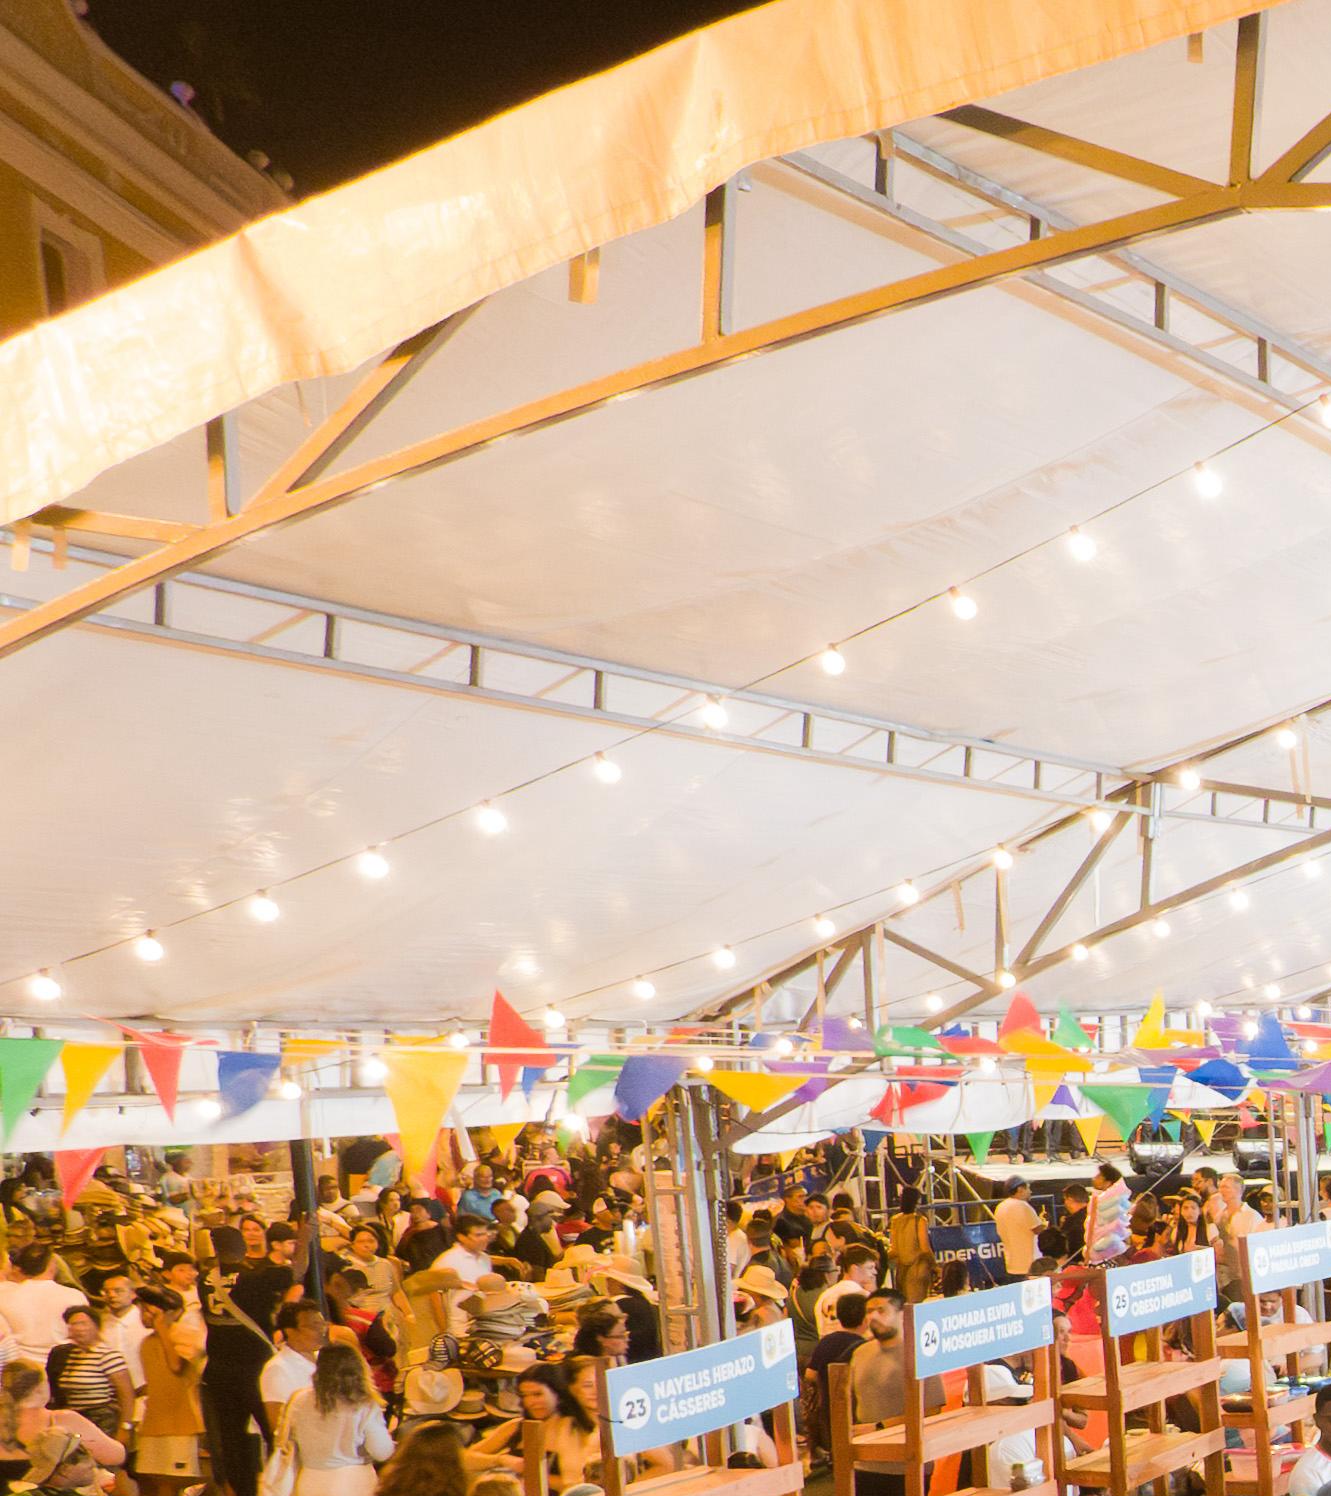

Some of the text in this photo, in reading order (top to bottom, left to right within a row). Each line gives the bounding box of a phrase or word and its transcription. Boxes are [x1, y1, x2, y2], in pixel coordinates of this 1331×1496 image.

[935, 1247, 976, 1264] uper
[1130, 1273, 1173, 1297] CELESTINA
[1116, 1294, 1127, 1310] 25
[1131, 1296, 1161, 1317] OBESO
[941, 1301, 1016, 1333] XIOMARA ELVIRA
[924, 1332, 937, 1348] 24
[941, 1319, 1024, 1353] MOSQUERA TILVES
[653, 1354, 756, 1400] NAYELIS HERAZO
[625, 1398, 647, 1420] 23
[656, 1387, 726, 1424] CÁSSERES
